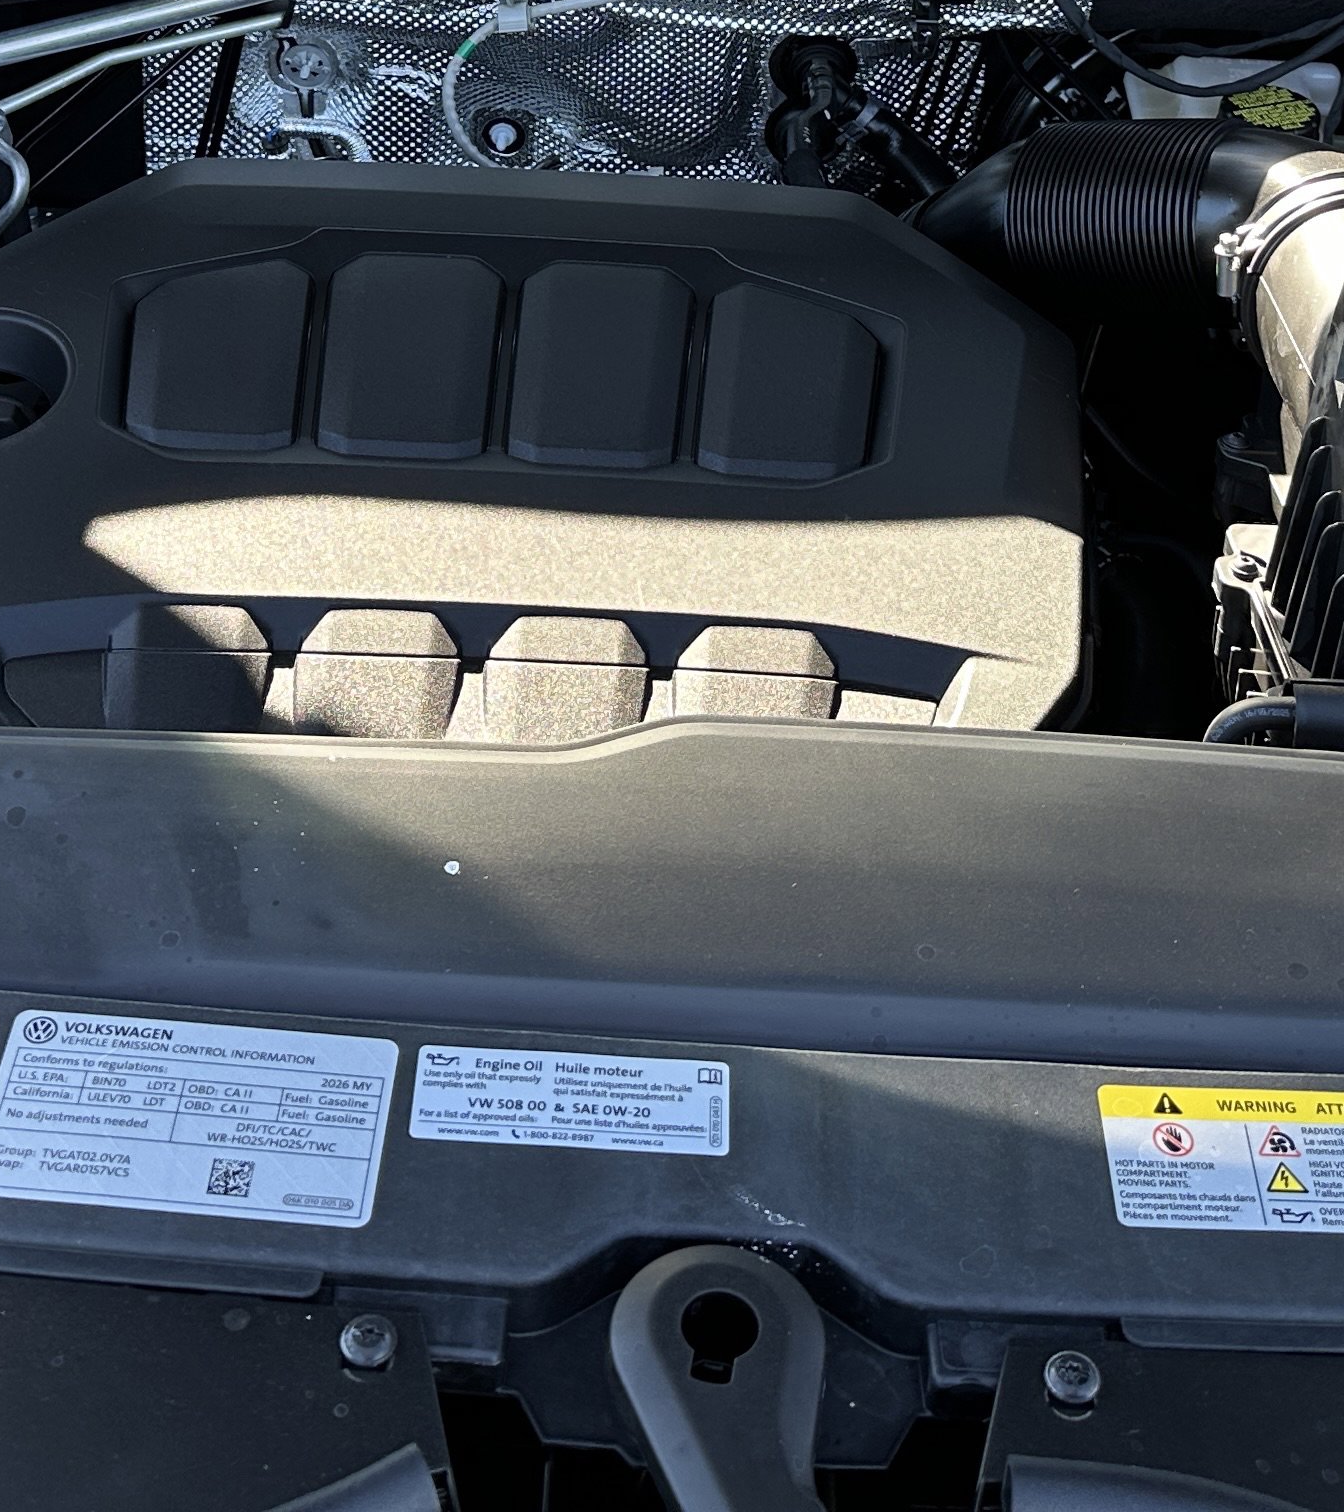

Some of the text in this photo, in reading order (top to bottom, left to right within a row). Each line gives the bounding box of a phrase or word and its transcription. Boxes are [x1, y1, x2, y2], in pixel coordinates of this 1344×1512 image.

[65, 1021, 174, 1041] VOLKSWAGEN
[60, 1034, 316, 1066] VEHICLE EMISSION CONTROL INFORMATION
[22, 1052, 169, 1078] Conforms to regulations:
[475, 1057, 543, 1073] Engine Oil
[555, 1061, 644, 1078] Huile moteur
[17, 1069, 69, 1084] U.S. EPA:
[91, 1075, 177, 1093] BIN70 LDT2
[320, 1077, 373, 1092] 2026 MY
[422, 1079, 487, 1090] complies with
[423, 1068, 542, 1086] Use only oil that expressly
[12, 1085, 74, 1101] California:
[187, 1083, 219, 1097] OBD:
[223, 1087, 241, 1098] CA
[553, 1076, 693, 1094] Utilisez uniquement de l'huile
[87, 1091, 167, 1107] ULEV70 LDT
[284, 1092, 370, 1110] Fuel: Gasoline
[552, 1086, 684, 1103] qui satisfait expressément à
[183, 1099, 215, 1113] OBD:
[219, 1103, 237, 1114] CA
[467, 1096, 651, 1119] VW 508 00 & SAE 0W-20
[1215, 1099, 1297, 1114] WARNING
[5, 1107, 149, 1129] No adjustments needed
[280, 1108, 367, 1126] Fuel: Gasoline
[418, 1107, 538, 1123] For a list of approved oils:
[551, 1115, 574, 1125] Pour
[573, 1118, 593, 1127] une
[593, 1117, 614, 1128] liste
[613, 1119, 650, 1130] d'huiles
[235, 1122, 313, 1139] DFI/TC/CAC/
[207, 1131, 337, 1153] WR-HO2S/HO2S/TWC
[1302, 1137, 1316, 1146] Le
[1114, 1158, 1216, 1171] HOT PARTS IN MOTOR
[1308, 1160, 1333, 1169] HIGH
[1117, 1177, 1158, 1188] MOVING
[1312, 1179, 1344, 1190] Haute
[1119, 1189, 1257, 1203] Composants très chauds dans
[1120, 1200, 1131, 1209] le
[1132, 1202, 1203, 1212] compartiment
[1122, 1211, 1155, 1221] Pièces
[1155, 1213, 1169, 1221] en
